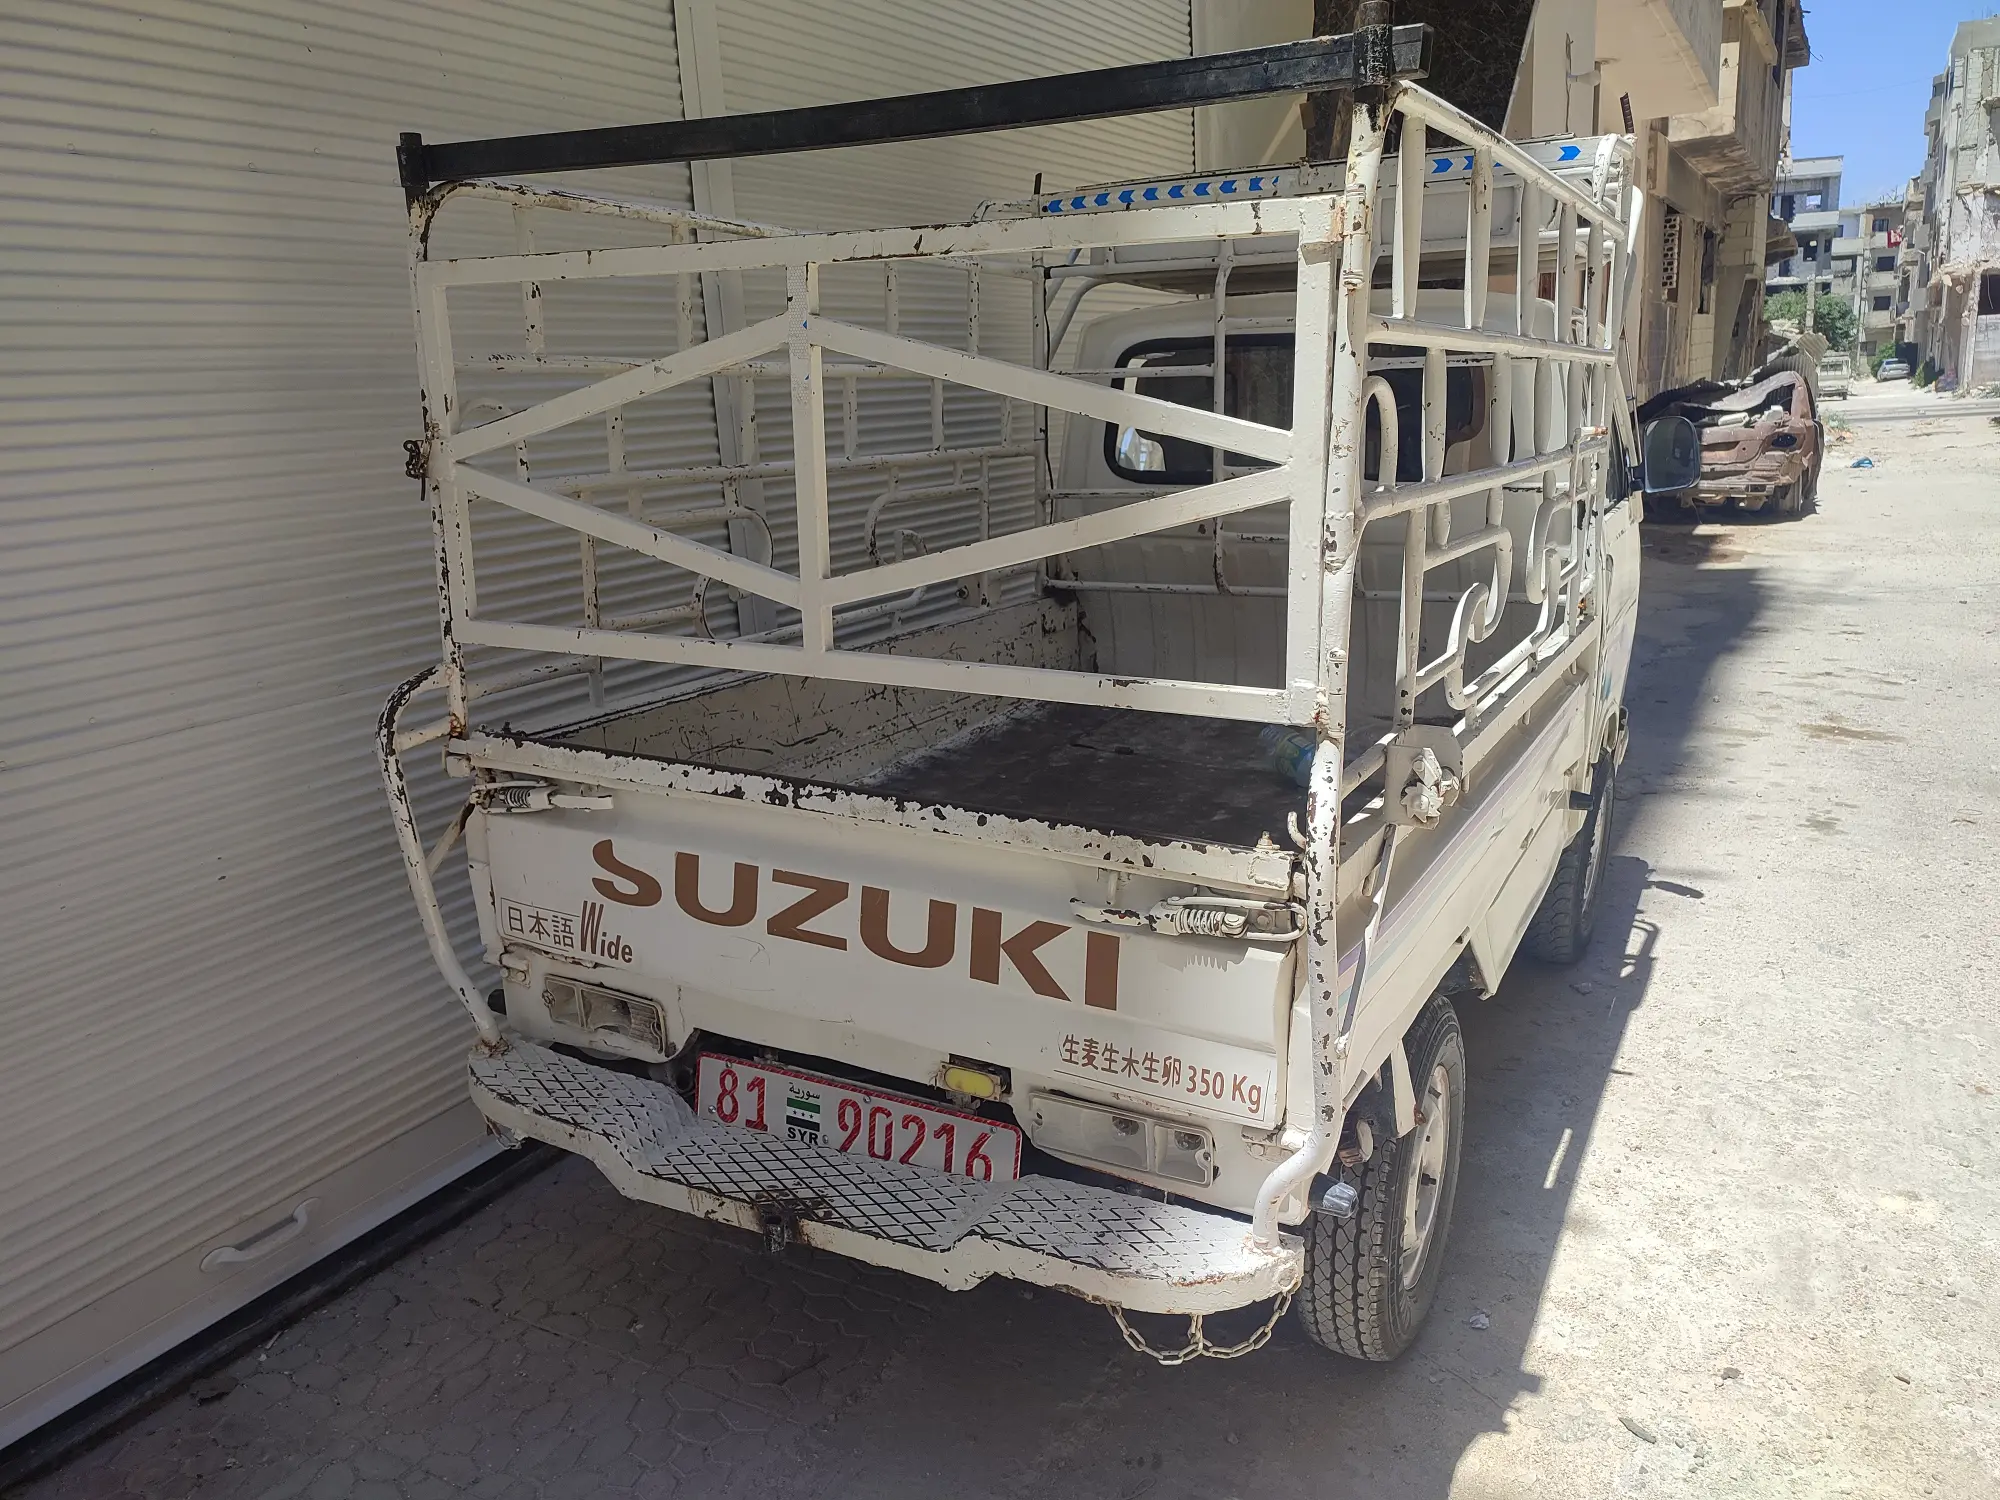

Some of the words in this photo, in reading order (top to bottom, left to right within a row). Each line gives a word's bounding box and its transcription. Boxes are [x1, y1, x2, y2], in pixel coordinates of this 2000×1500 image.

[506, 905, 576, 949] 日本語
[580, 900, 633, 963] Wide
[592, 839, 1120, 1011] SUZUKI
[789, 1082, 820, 1100] سورية
[1186, 1065, 1225, 1100] 350
[1231, 1074, 1262, 1114] Kg
[717, 1068, 768, 1132] 81
[837, 1098, 992, 1182] 90216
[787, 1127, 818, 1145] SYR
